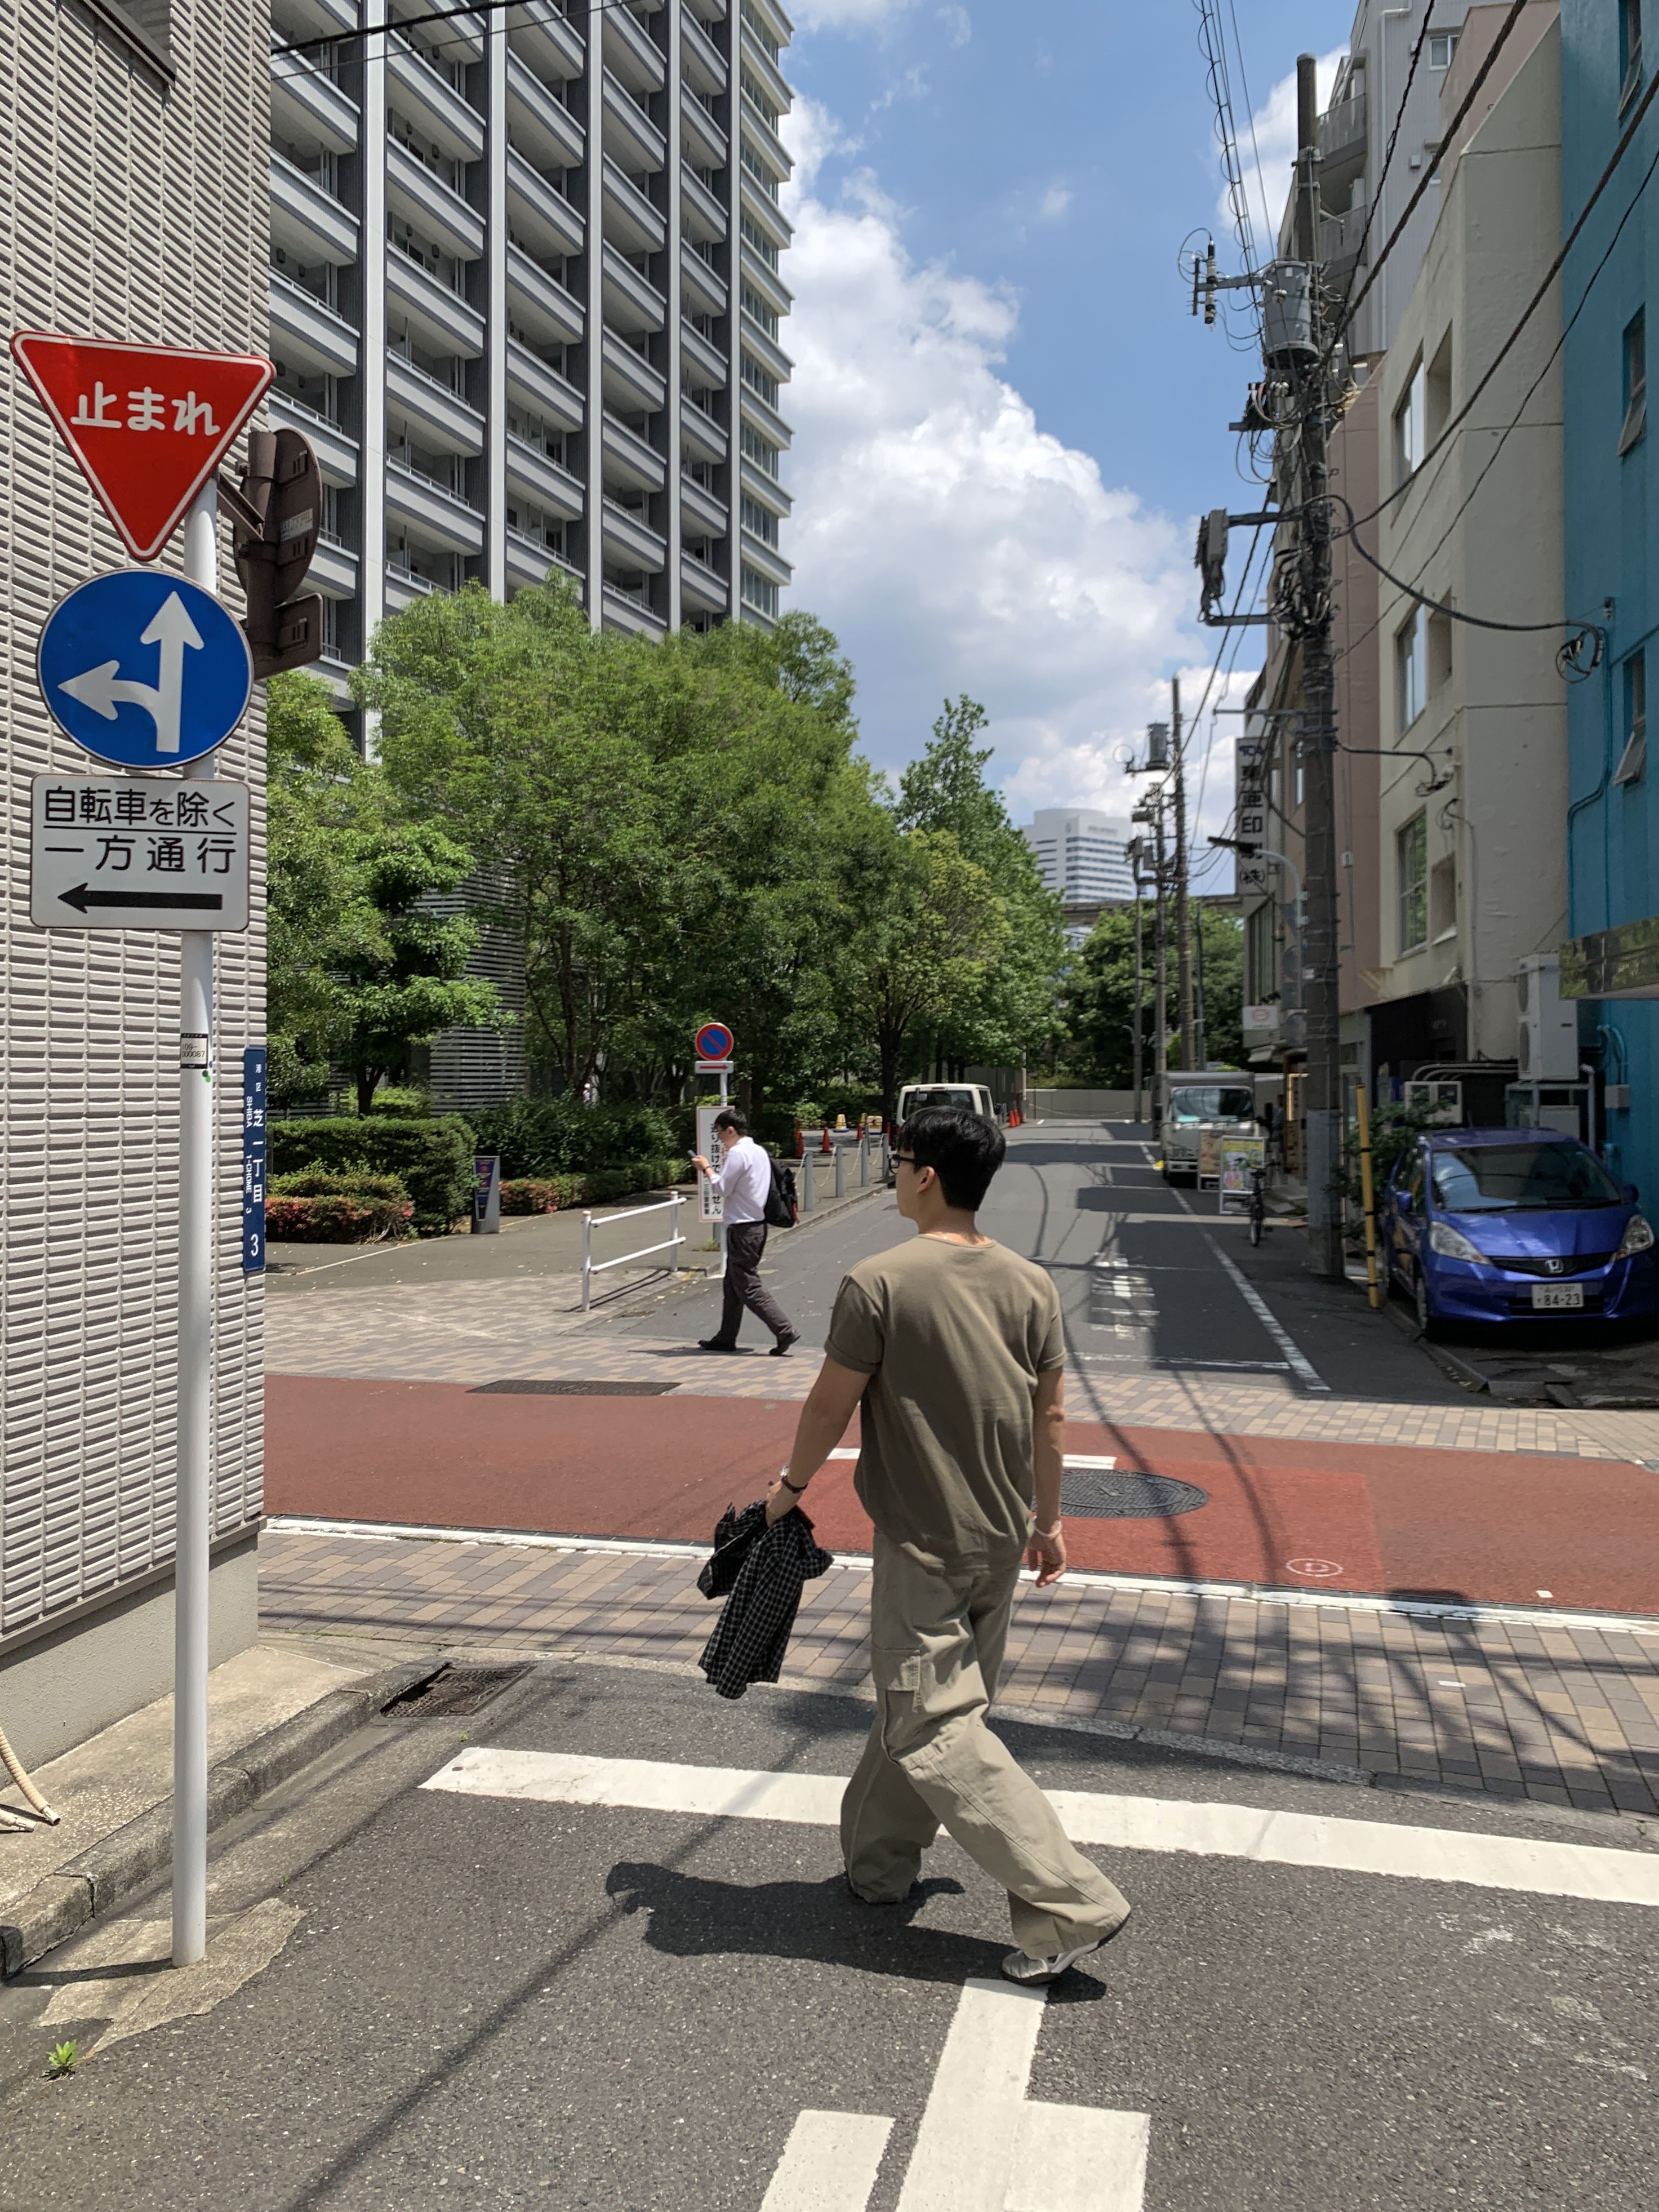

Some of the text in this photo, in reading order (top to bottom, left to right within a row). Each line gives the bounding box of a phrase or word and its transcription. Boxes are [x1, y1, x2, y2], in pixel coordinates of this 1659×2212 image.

[70, 381, 221, 436] 止まれ
[45, 785, 235, 828] 自転車を除く
[44, 834, 237, 874] 一方通行
[253, 1108, 264, 1203] 芝一丁目
[251, 1233, 259, 1257] 3
